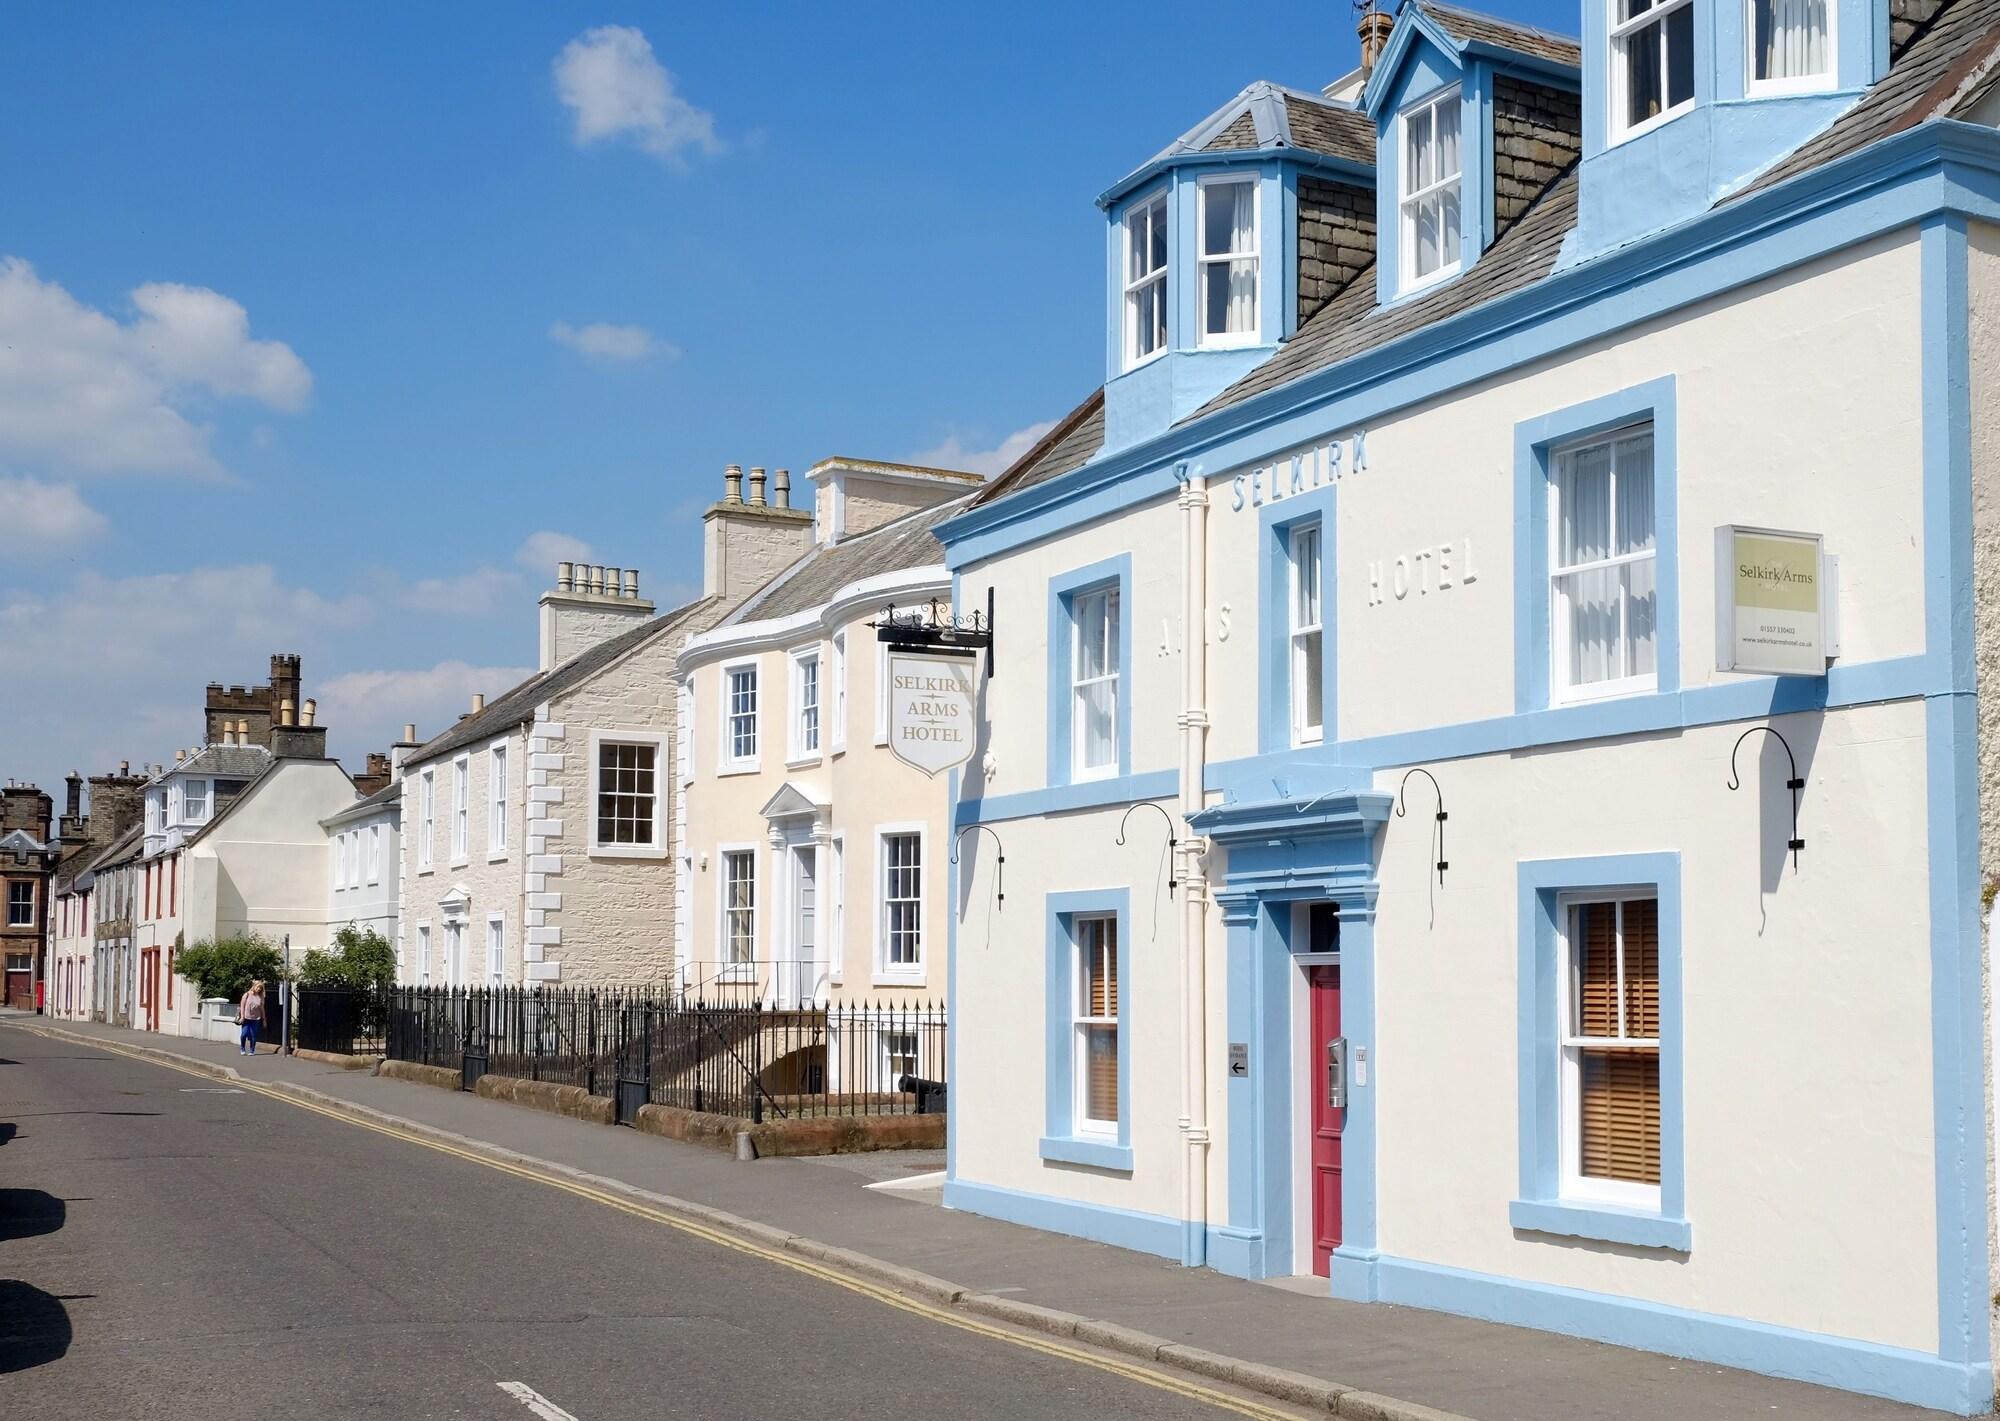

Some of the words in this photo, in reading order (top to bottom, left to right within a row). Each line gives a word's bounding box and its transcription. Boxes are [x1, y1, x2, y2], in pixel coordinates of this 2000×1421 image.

[1232, 429, 1367, 512] SELKIRK
[1368, 538, 1477, 607] HOTEL
[1740, 564, 1780, 581] Selkirk
[1783, 569, 1813, 584] Arms
[894, 675, 969, 692] SELKIRK
[907, 702, 959, 717] ARMS
[902, 726, 963, 742] HOTEL
